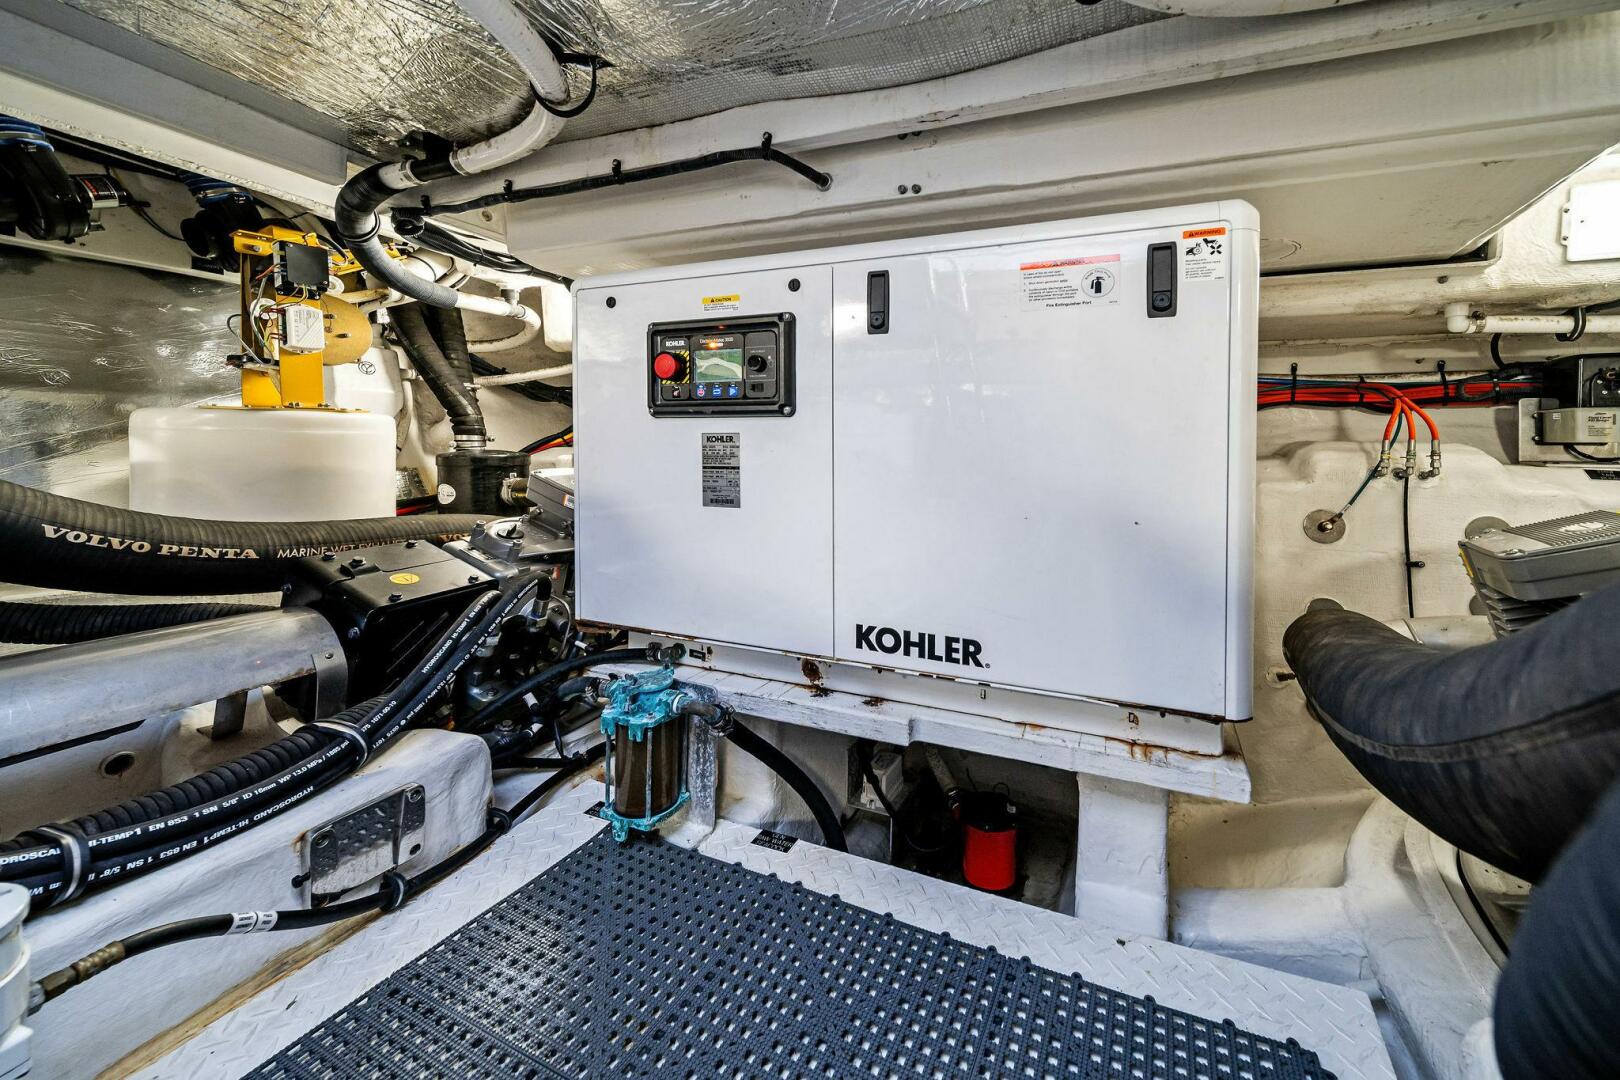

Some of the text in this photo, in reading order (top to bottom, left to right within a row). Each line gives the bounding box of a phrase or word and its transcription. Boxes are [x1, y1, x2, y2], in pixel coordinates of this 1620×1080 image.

[706, 435, 734, 443] KOHLER
[41, 524, 151, 553] VOLVO
[157, 543, 260, 559] PENTA
[421, 639, 453, 674] HYDROSCAND
[856, 623, 985, 669] KOHLER
[149, 822, 165, 832] EN
[167, 815, 188, 827] 853
[202, 805, 218, 815] SN
[242, 791, 253, 800] ID
[254, 782, 277, 796] 16mm
[278, 773, 292, 783] WP
[340, 740, 350, 750] psi
[253, 785, 314, 821] HYDROSCAND
[182, 841, 197, 851] EN
[126, 859, 144, 870] SN
